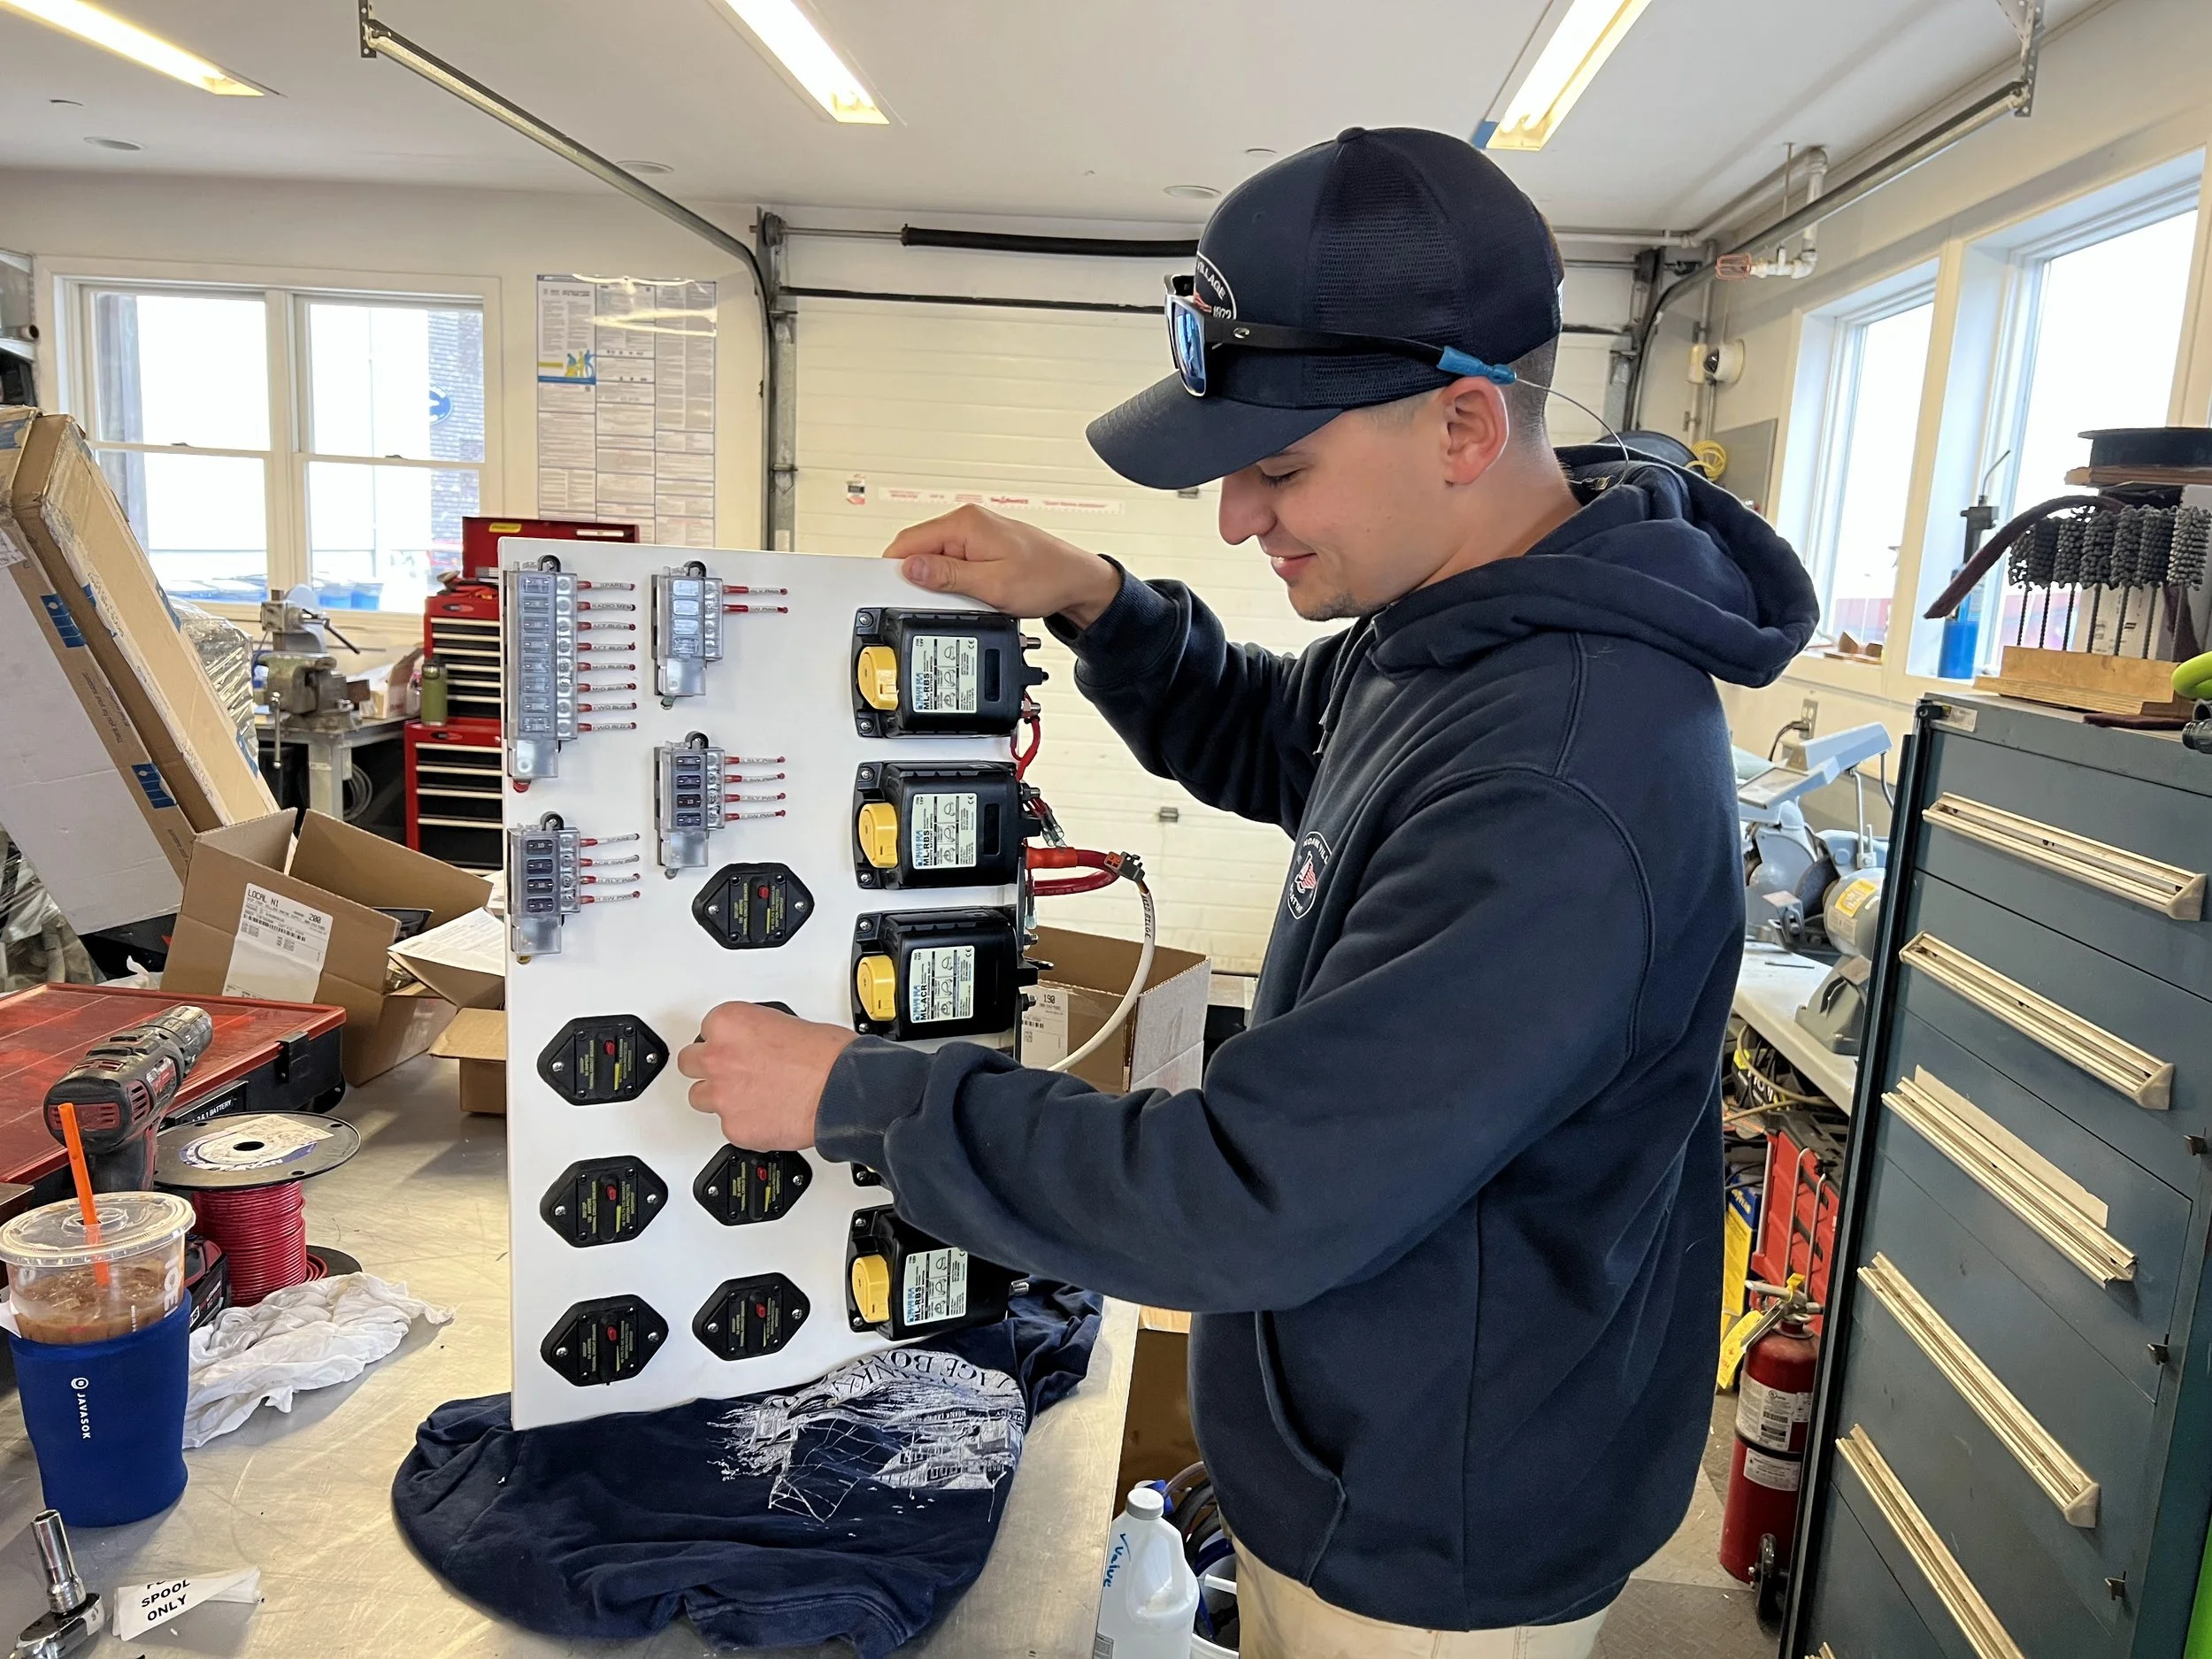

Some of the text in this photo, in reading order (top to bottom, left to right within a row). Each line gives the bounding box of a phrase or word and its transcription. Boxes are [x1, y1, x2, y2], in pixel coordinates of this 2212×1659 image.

[1213, 305, 1232, 319] 1872
[248, 888, 266, 903] LOCAL
[309, 913, 321, 924] 200
[1044, 994, 1056, 1004] 190
[209, 1099, 232, 1117] BATTERY
[77, 1393, 91, 1440] JAVASOK
[142, 1579, 190, 1608] SPOOL
[147, 1594, 187, 1621] ONLY
